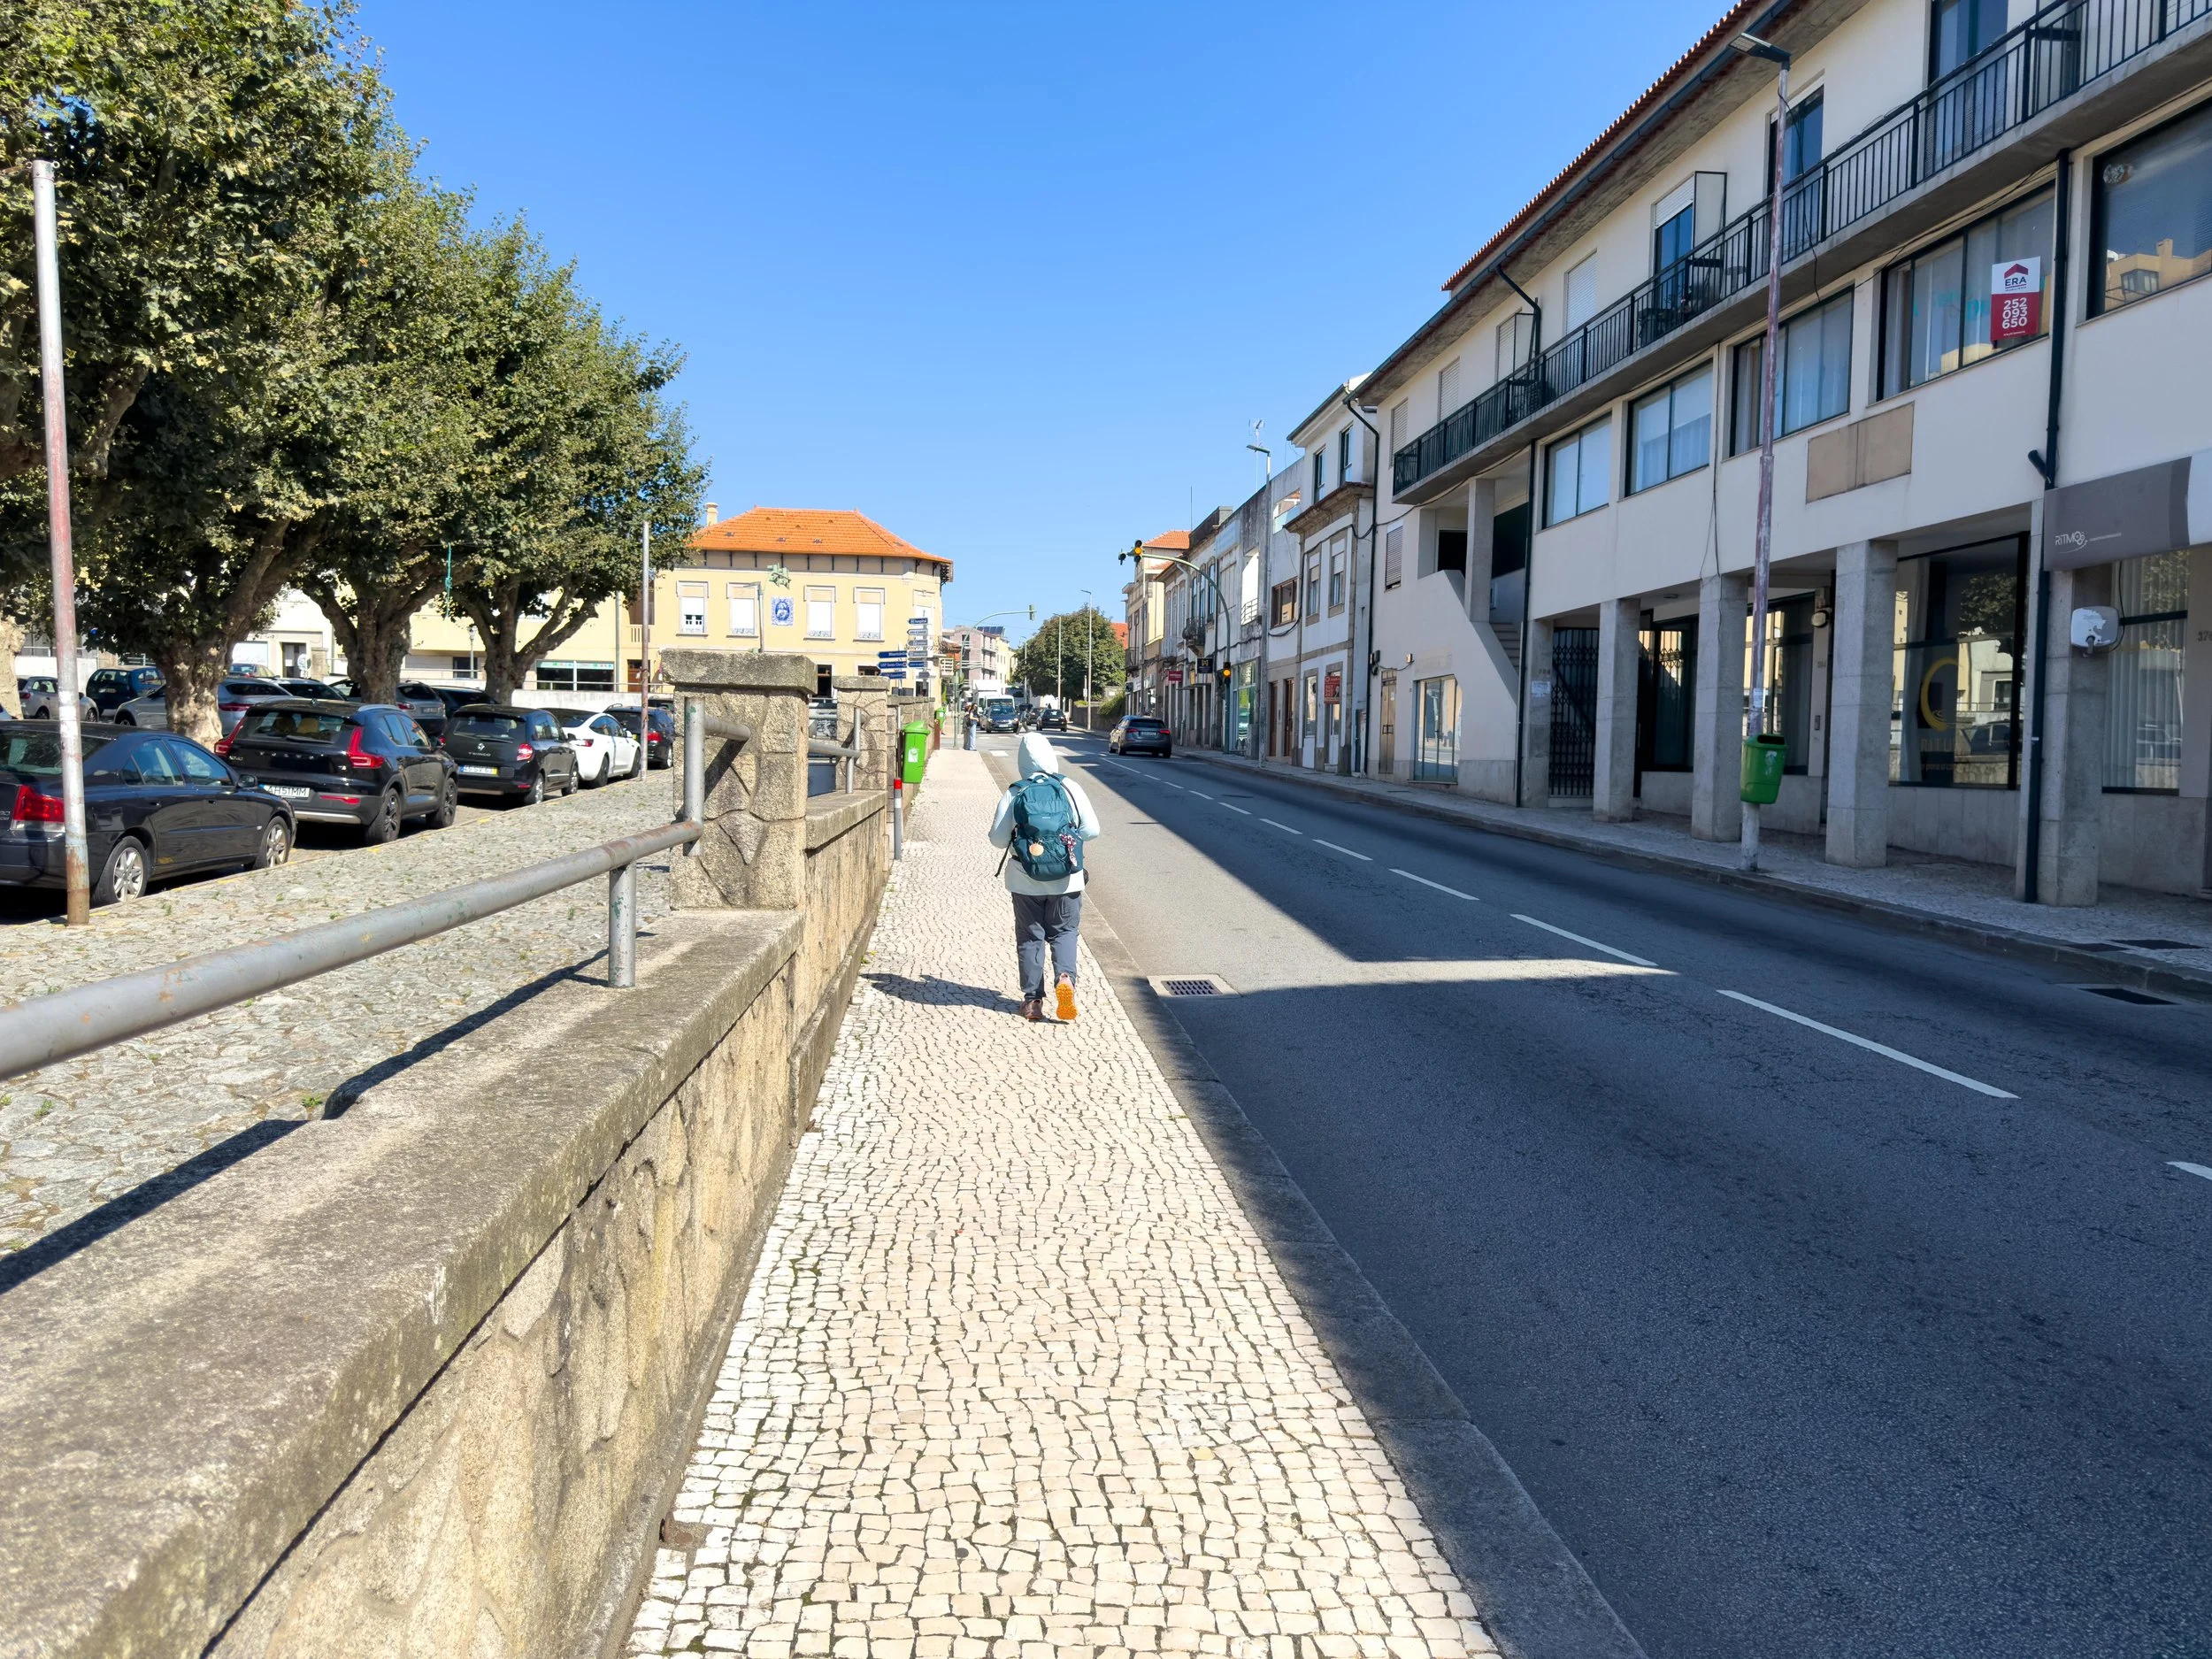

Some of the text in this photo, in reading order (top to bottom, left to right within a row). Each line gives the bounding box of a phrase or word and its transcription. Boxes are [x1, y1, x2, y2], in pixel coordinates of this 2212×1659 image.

[2005, 276, 2026, 287] ERA
[2004, 297, 2027, 310] 252
[2002, 307, 2028, 319] 093
[2002, 317, 2028, 329] 650
